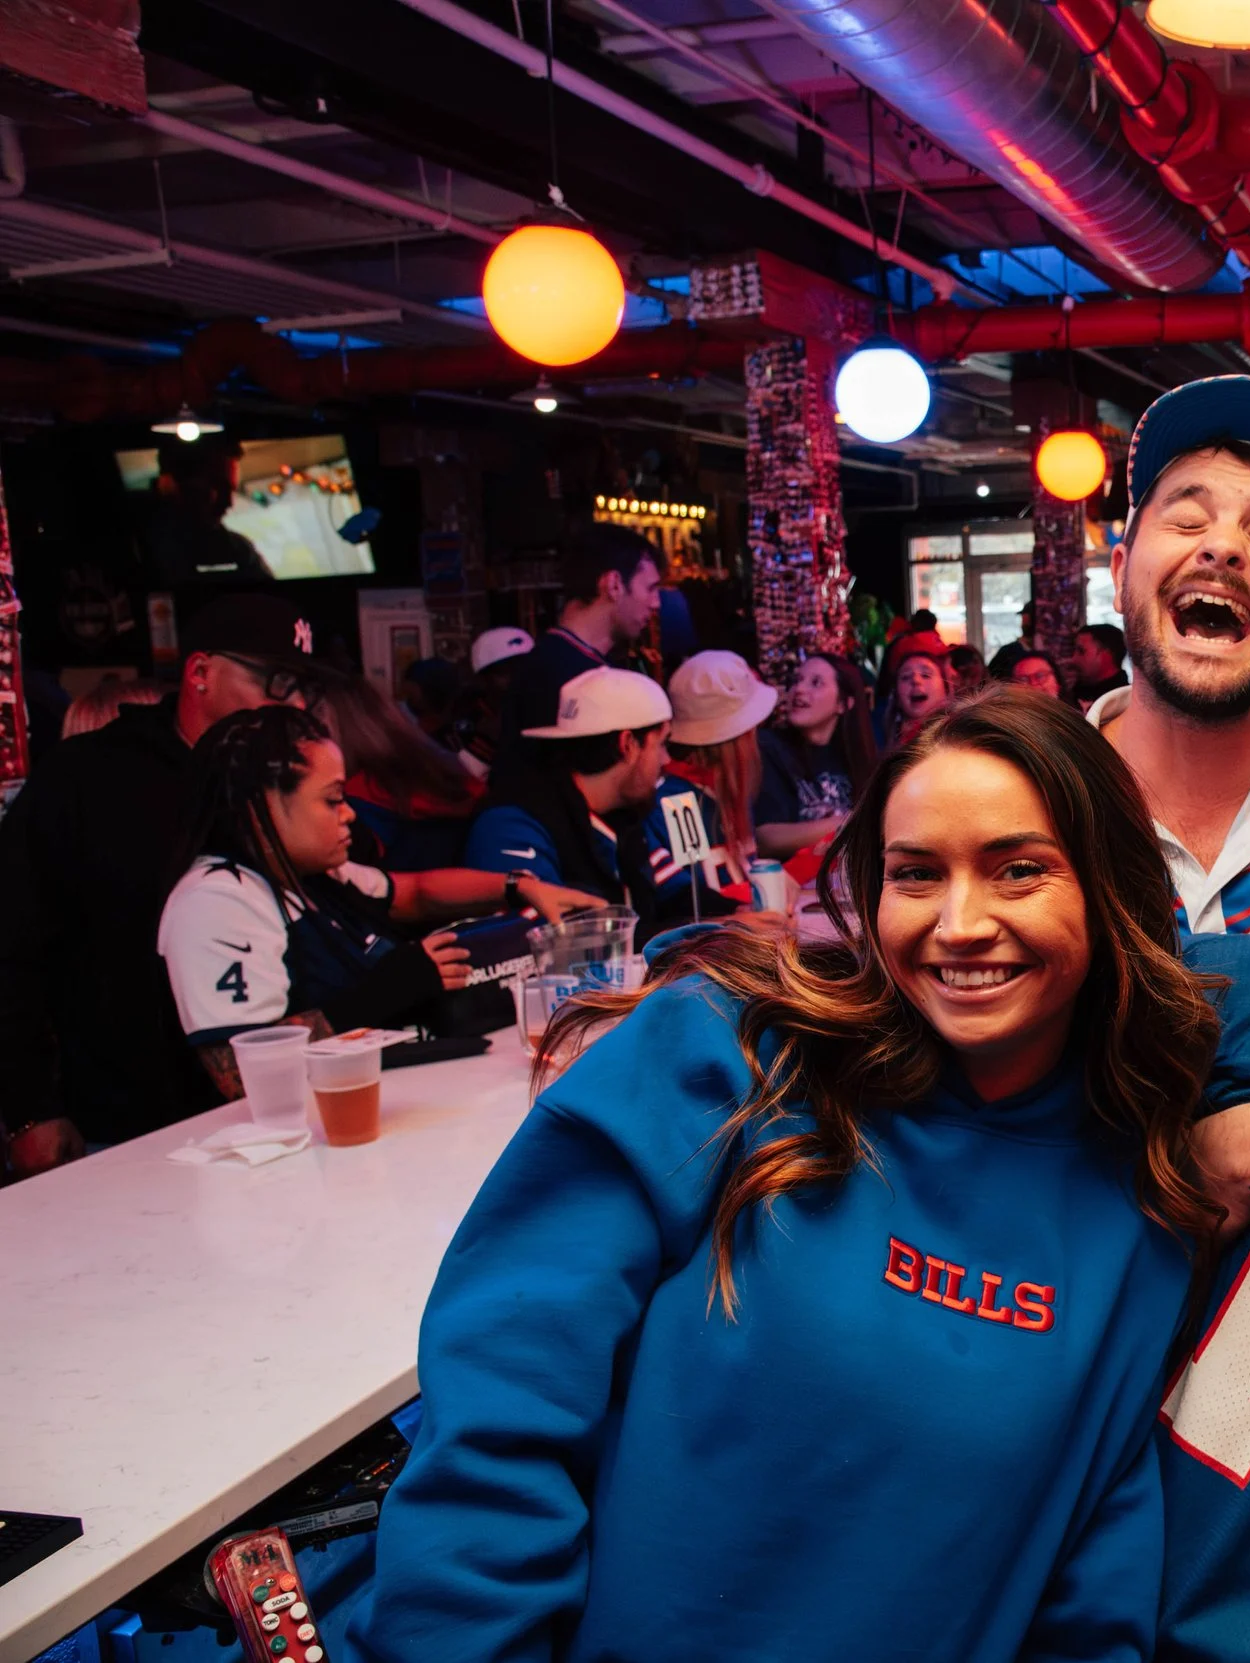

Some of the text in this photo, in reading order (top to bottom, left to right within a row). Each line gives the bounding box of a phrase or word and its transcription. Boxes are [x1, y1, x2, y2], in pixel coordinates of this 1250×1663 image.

[671, 805, 701, 853] 10
[216, 961, 249, 1004] 4
[884, 1236, 1056, 1333] BILLS
[271, 1595, 291, 1607] SODA
